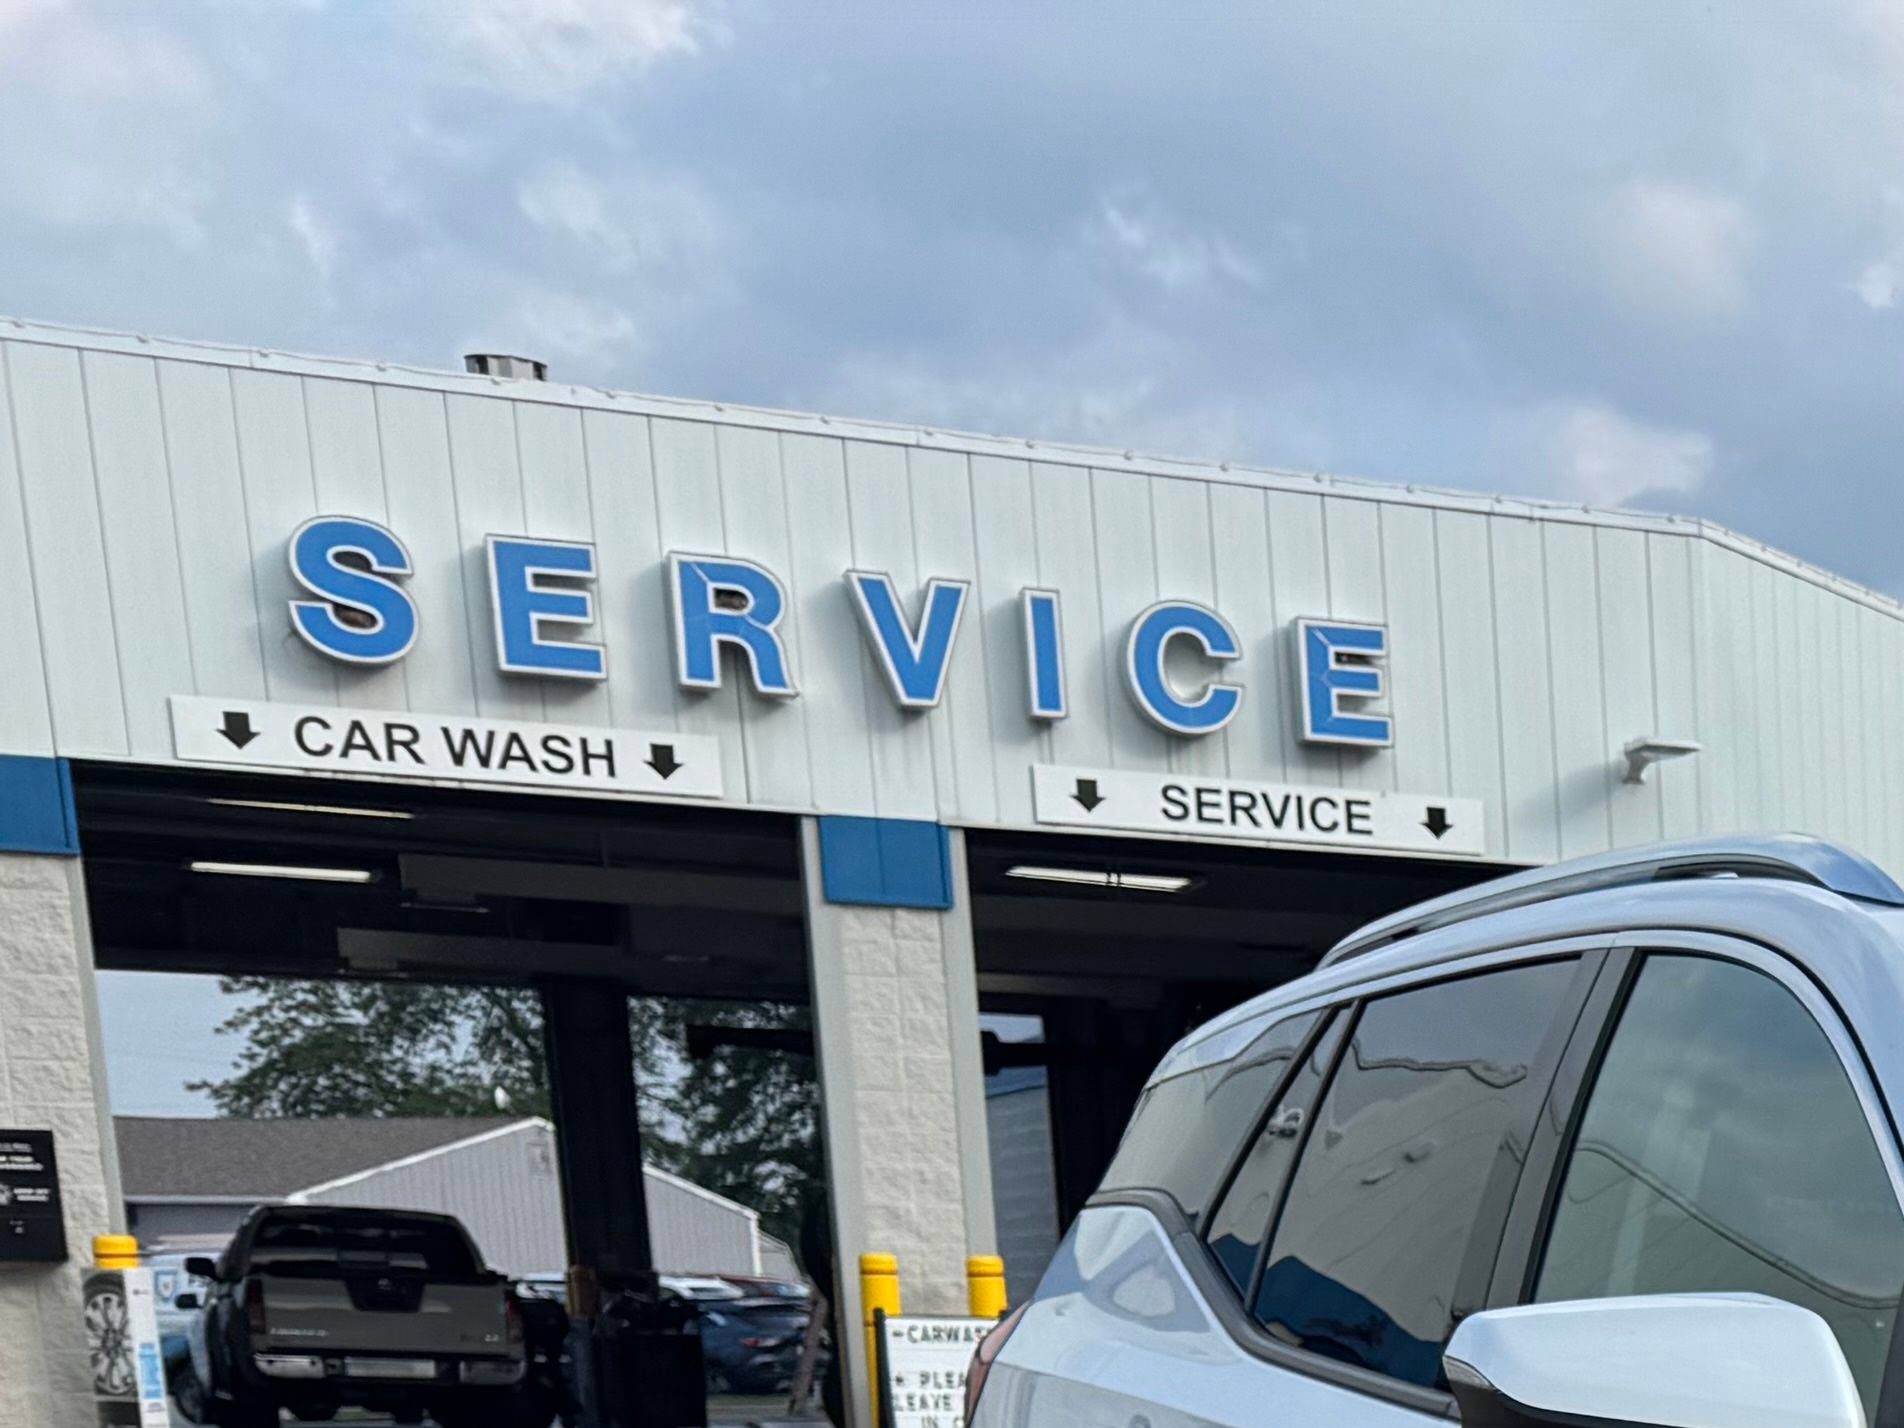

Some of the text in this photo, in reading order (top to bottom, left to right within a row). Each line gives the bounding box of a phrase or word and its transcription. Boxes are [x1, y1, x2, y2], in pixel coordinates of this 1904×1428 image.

[287, 513, 1395, 748] SERVICE
[292, 714, 618, 779] CAR WASH
[1159, 783, 1375, 837] SERVICE
[907, 1325, 992, 1343] CARWA
[919, 1370, 966, 1389] PLEA
